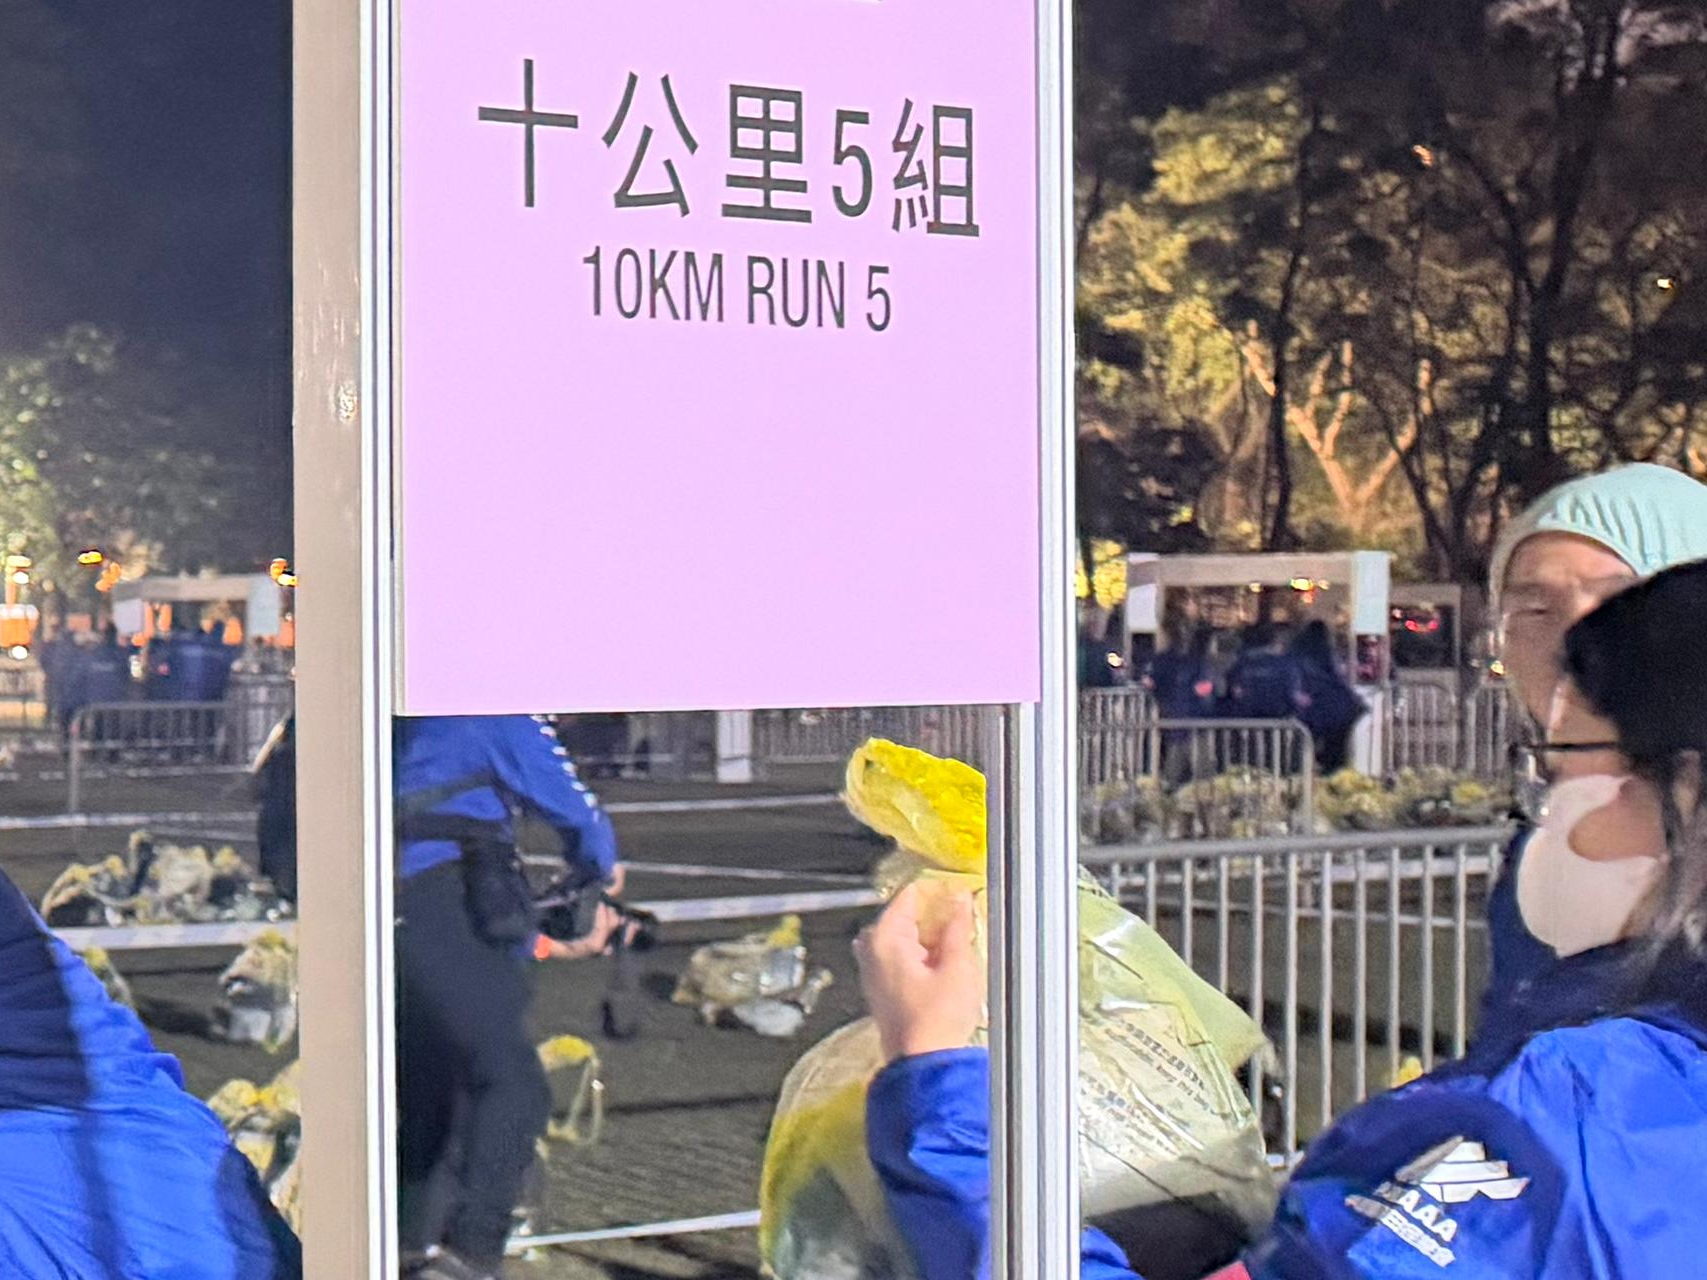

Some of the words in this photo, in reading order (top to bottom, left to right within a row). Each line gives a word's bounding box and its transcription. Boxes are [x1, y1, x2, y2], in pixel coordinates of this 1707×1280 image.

[477, 57, 980, 238] 十公里5組
[581, 244, 726, 325] 10KM
[747, 255, 846, 330] RUN
[864, 264, 892, 333] 5
